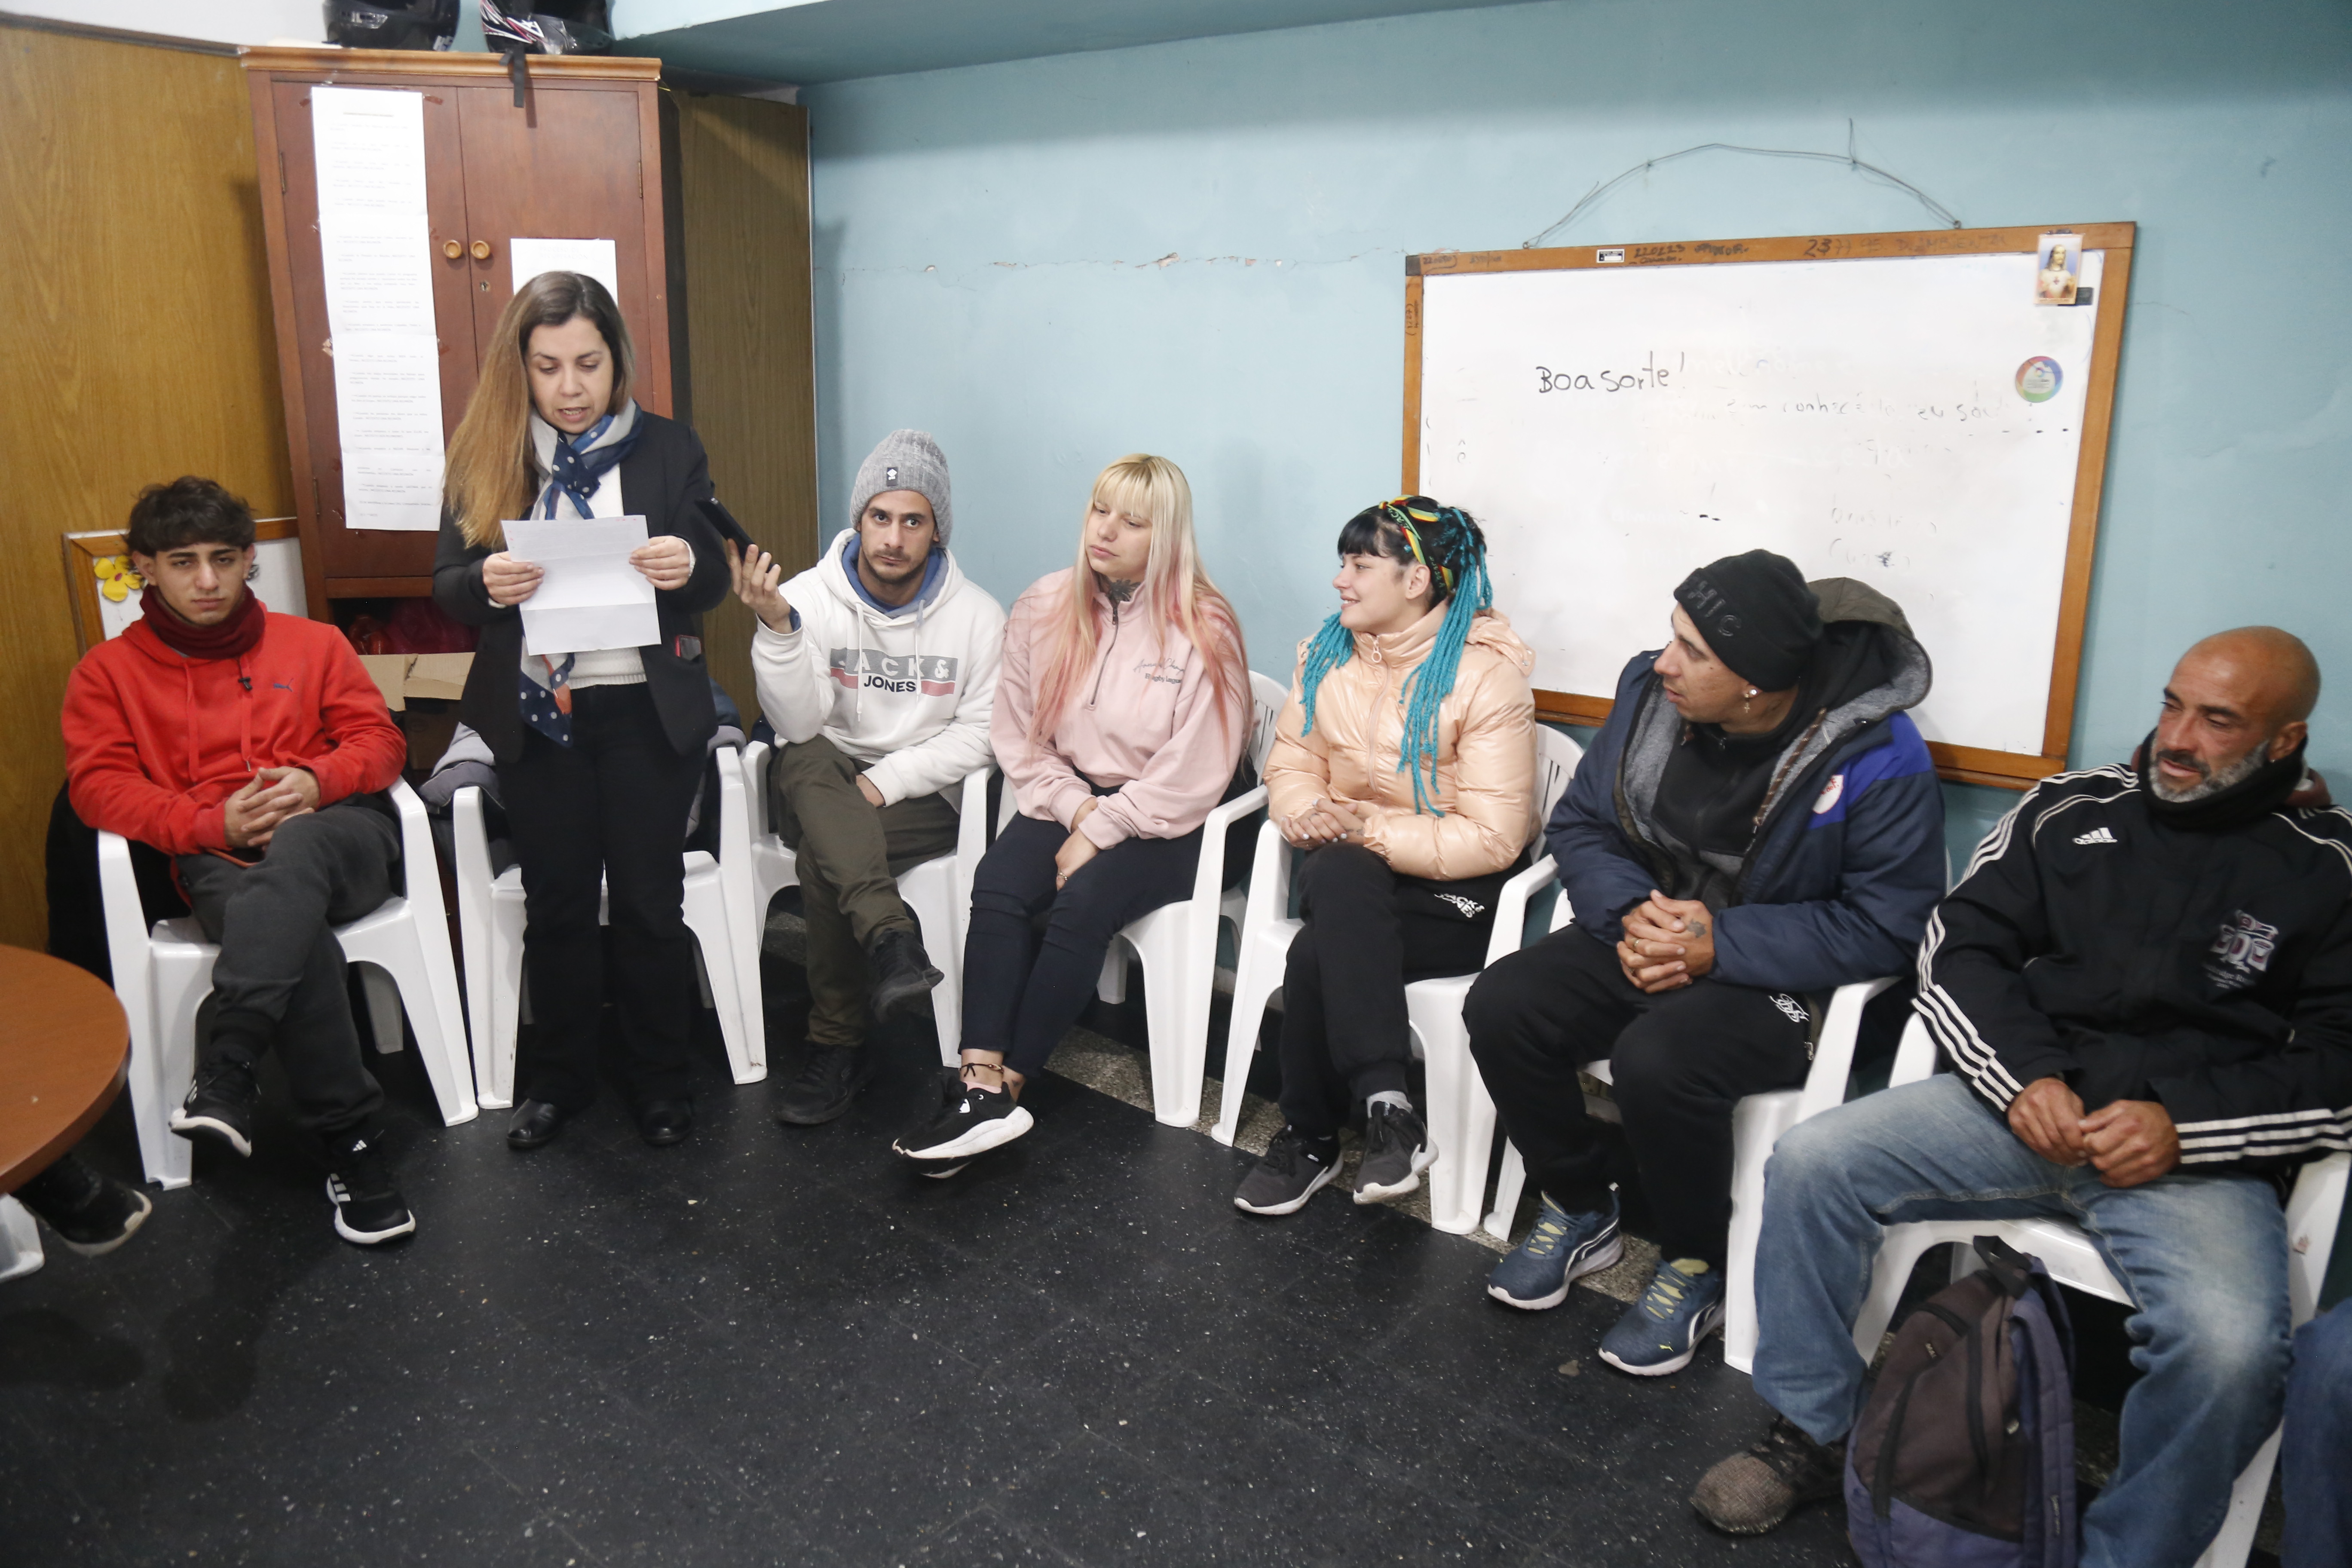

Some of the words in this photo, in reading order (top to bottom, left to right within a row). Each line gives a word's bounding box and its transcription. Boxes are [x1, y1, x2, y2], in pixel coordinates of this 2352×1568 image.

[1535, 366, 1595, 393] Boa
[838, 651, 925, 677] ACK
[864, 675, 916, 693] JONES
